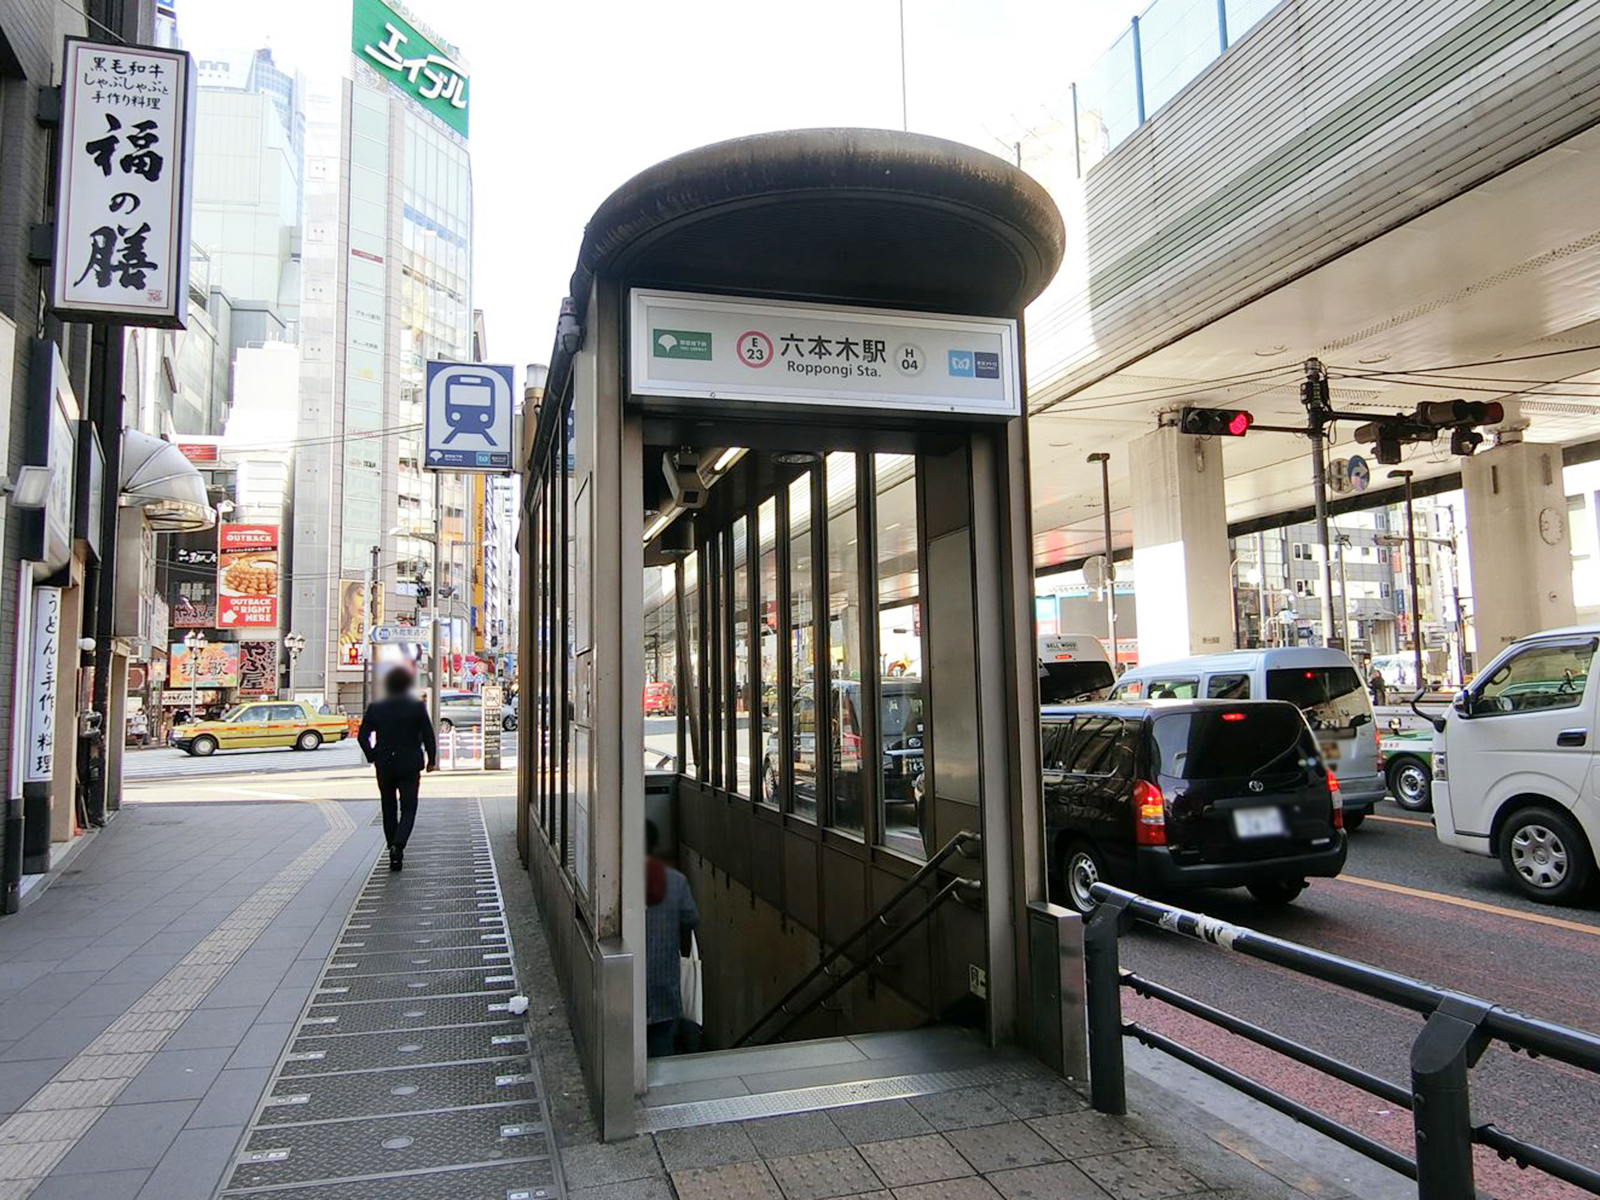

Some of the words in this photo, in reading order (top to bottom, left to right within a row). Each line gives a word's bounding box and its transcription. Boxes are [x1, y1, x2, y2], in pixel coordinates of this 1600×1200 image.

[90, 57, 164, 78] 黒毛和牛
[364, 22, 469, 109] エイブル
[84, 72, 169, 95] しゃぶしゃぶと
[91, 90, 161, 110] 手作り料理
[73, 113, 163, 290] 福の膳
[752, 337, 758, 348] E
[780, 333, 887, 364] 六本木駅
[747, 349, 764, 361] 23
[905, 348, 914, 358] H
[787, 360, 852, 378] Roppongi
[857, 366, 882, 378] Sta.
[902, 359, 918, 371] 04
[226, 534, 272, 542] OUTBACK
[245, 614, 271, 622] HERE
[240, 641, 266, 689] やぶ屋
[36, 594, 57, 774] うどんと手作り料理
